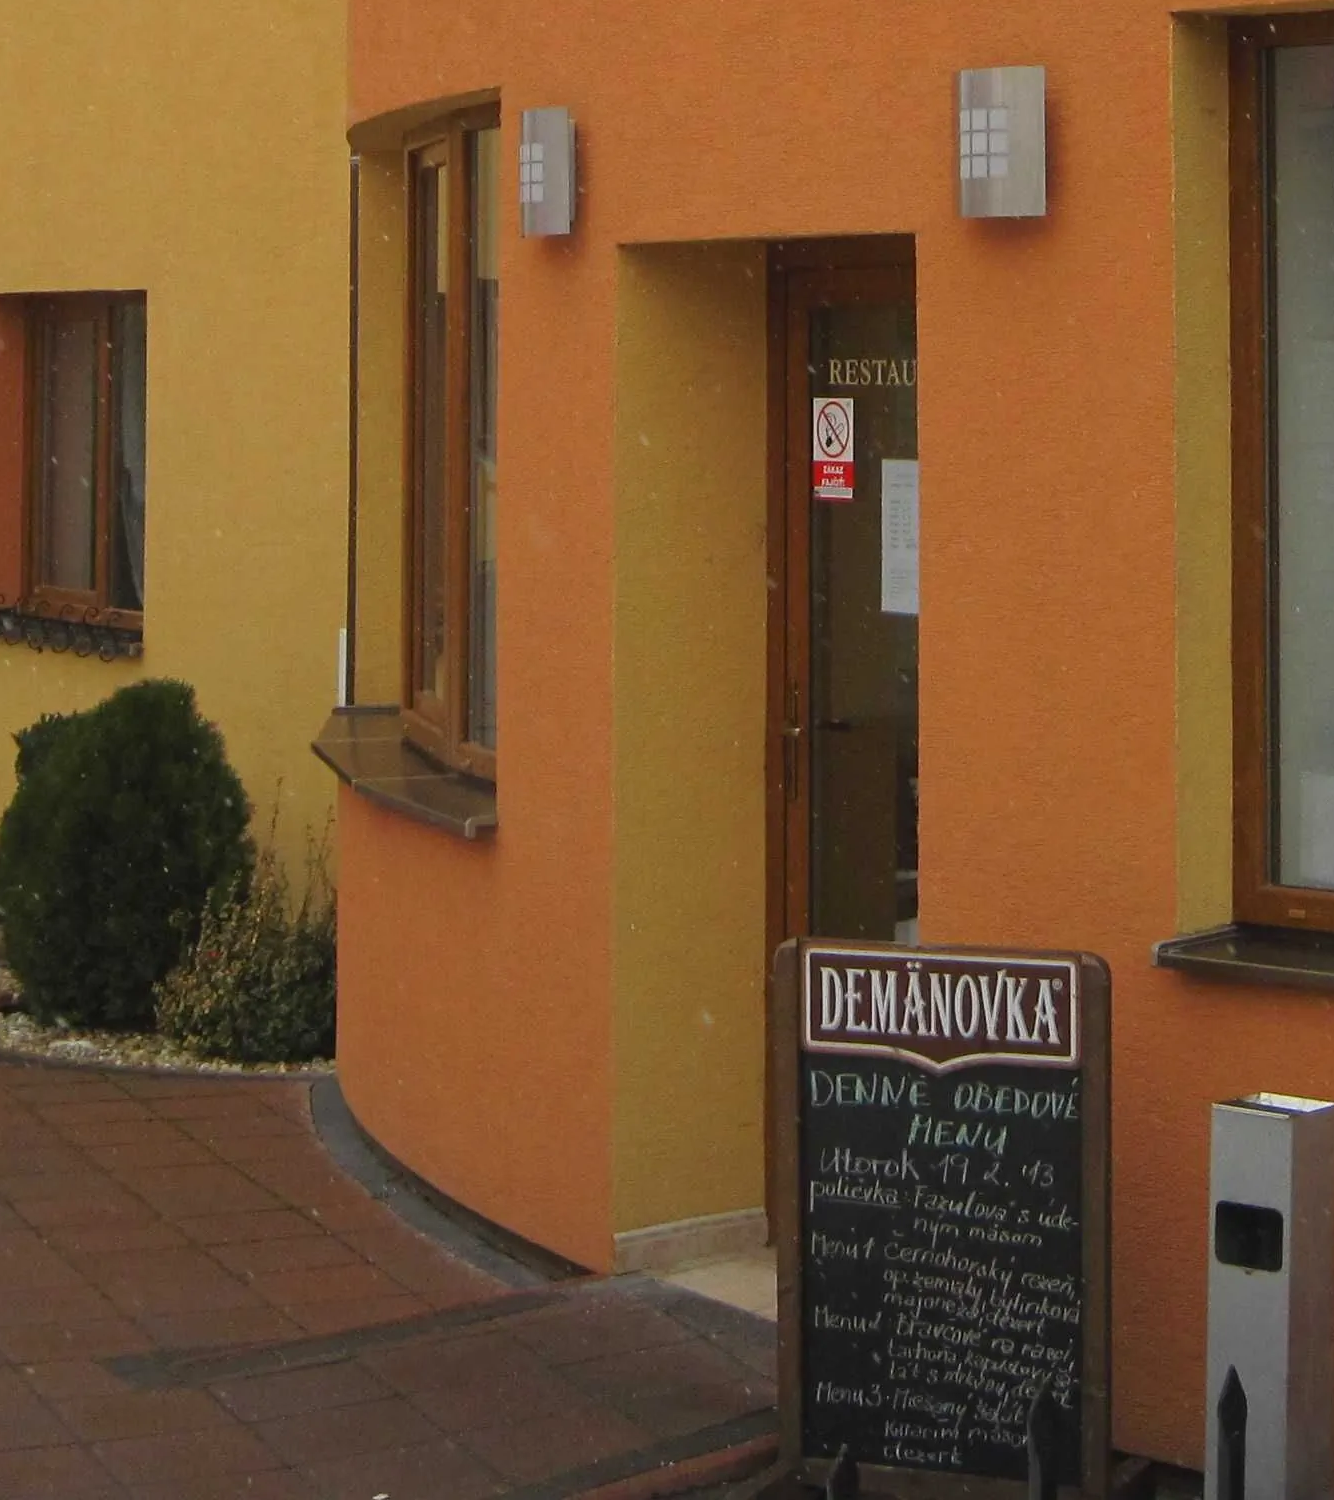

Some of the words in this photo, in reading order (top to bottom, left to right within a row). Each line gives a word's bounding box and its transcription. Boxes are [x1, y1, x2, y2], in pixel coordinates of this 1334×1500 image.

[953, 1077, 1079, 1120] OBEDOVÉ
[907, 1113, 1007, 1156] MENU
[819, 1147, 919, 1181] Utorok
